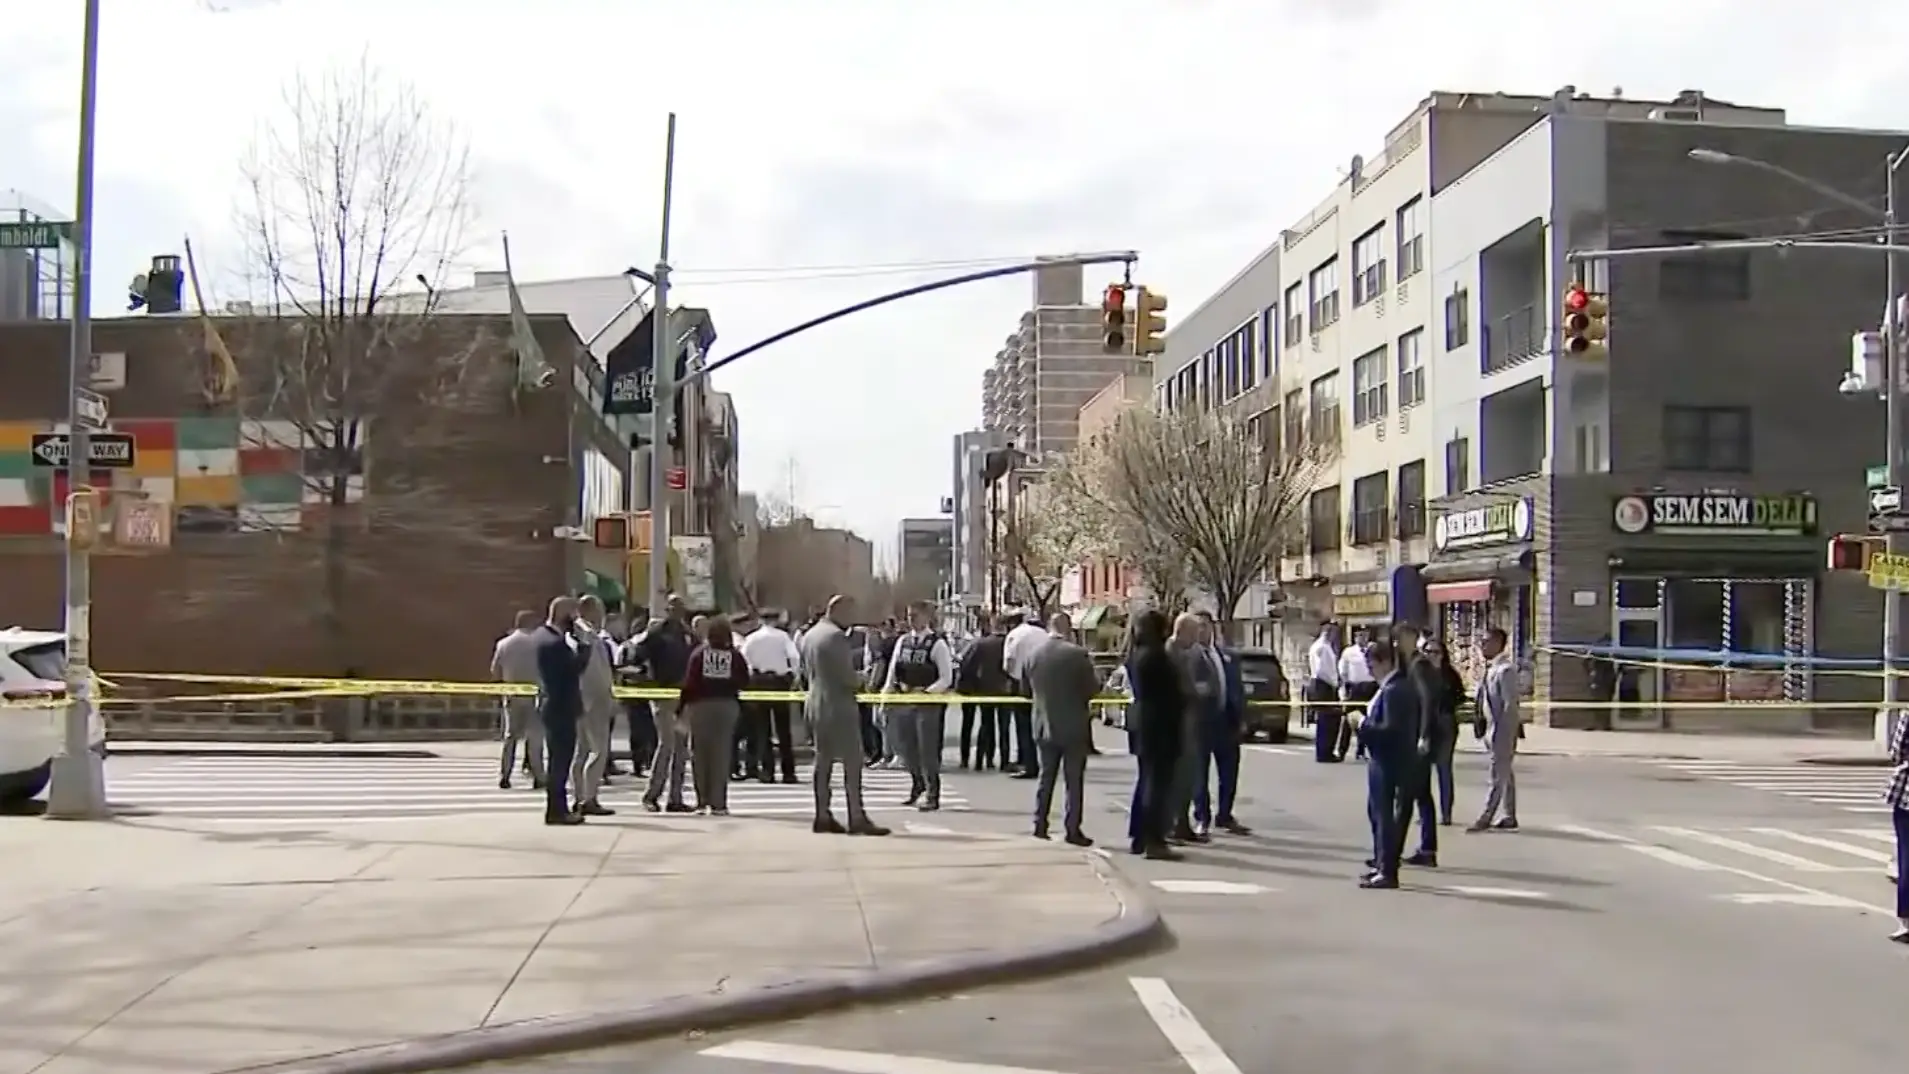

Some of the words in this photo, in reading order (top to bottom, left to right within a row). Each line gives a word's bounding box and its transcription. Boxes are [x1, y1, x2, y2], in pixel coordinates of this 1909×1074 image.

[93, 444, 126, 459] WAY
[1654, 497, 1699, 524] SEM
[1702, 497, 1748, 524] SEM
[1754, 496, 1801, 524] DELI
